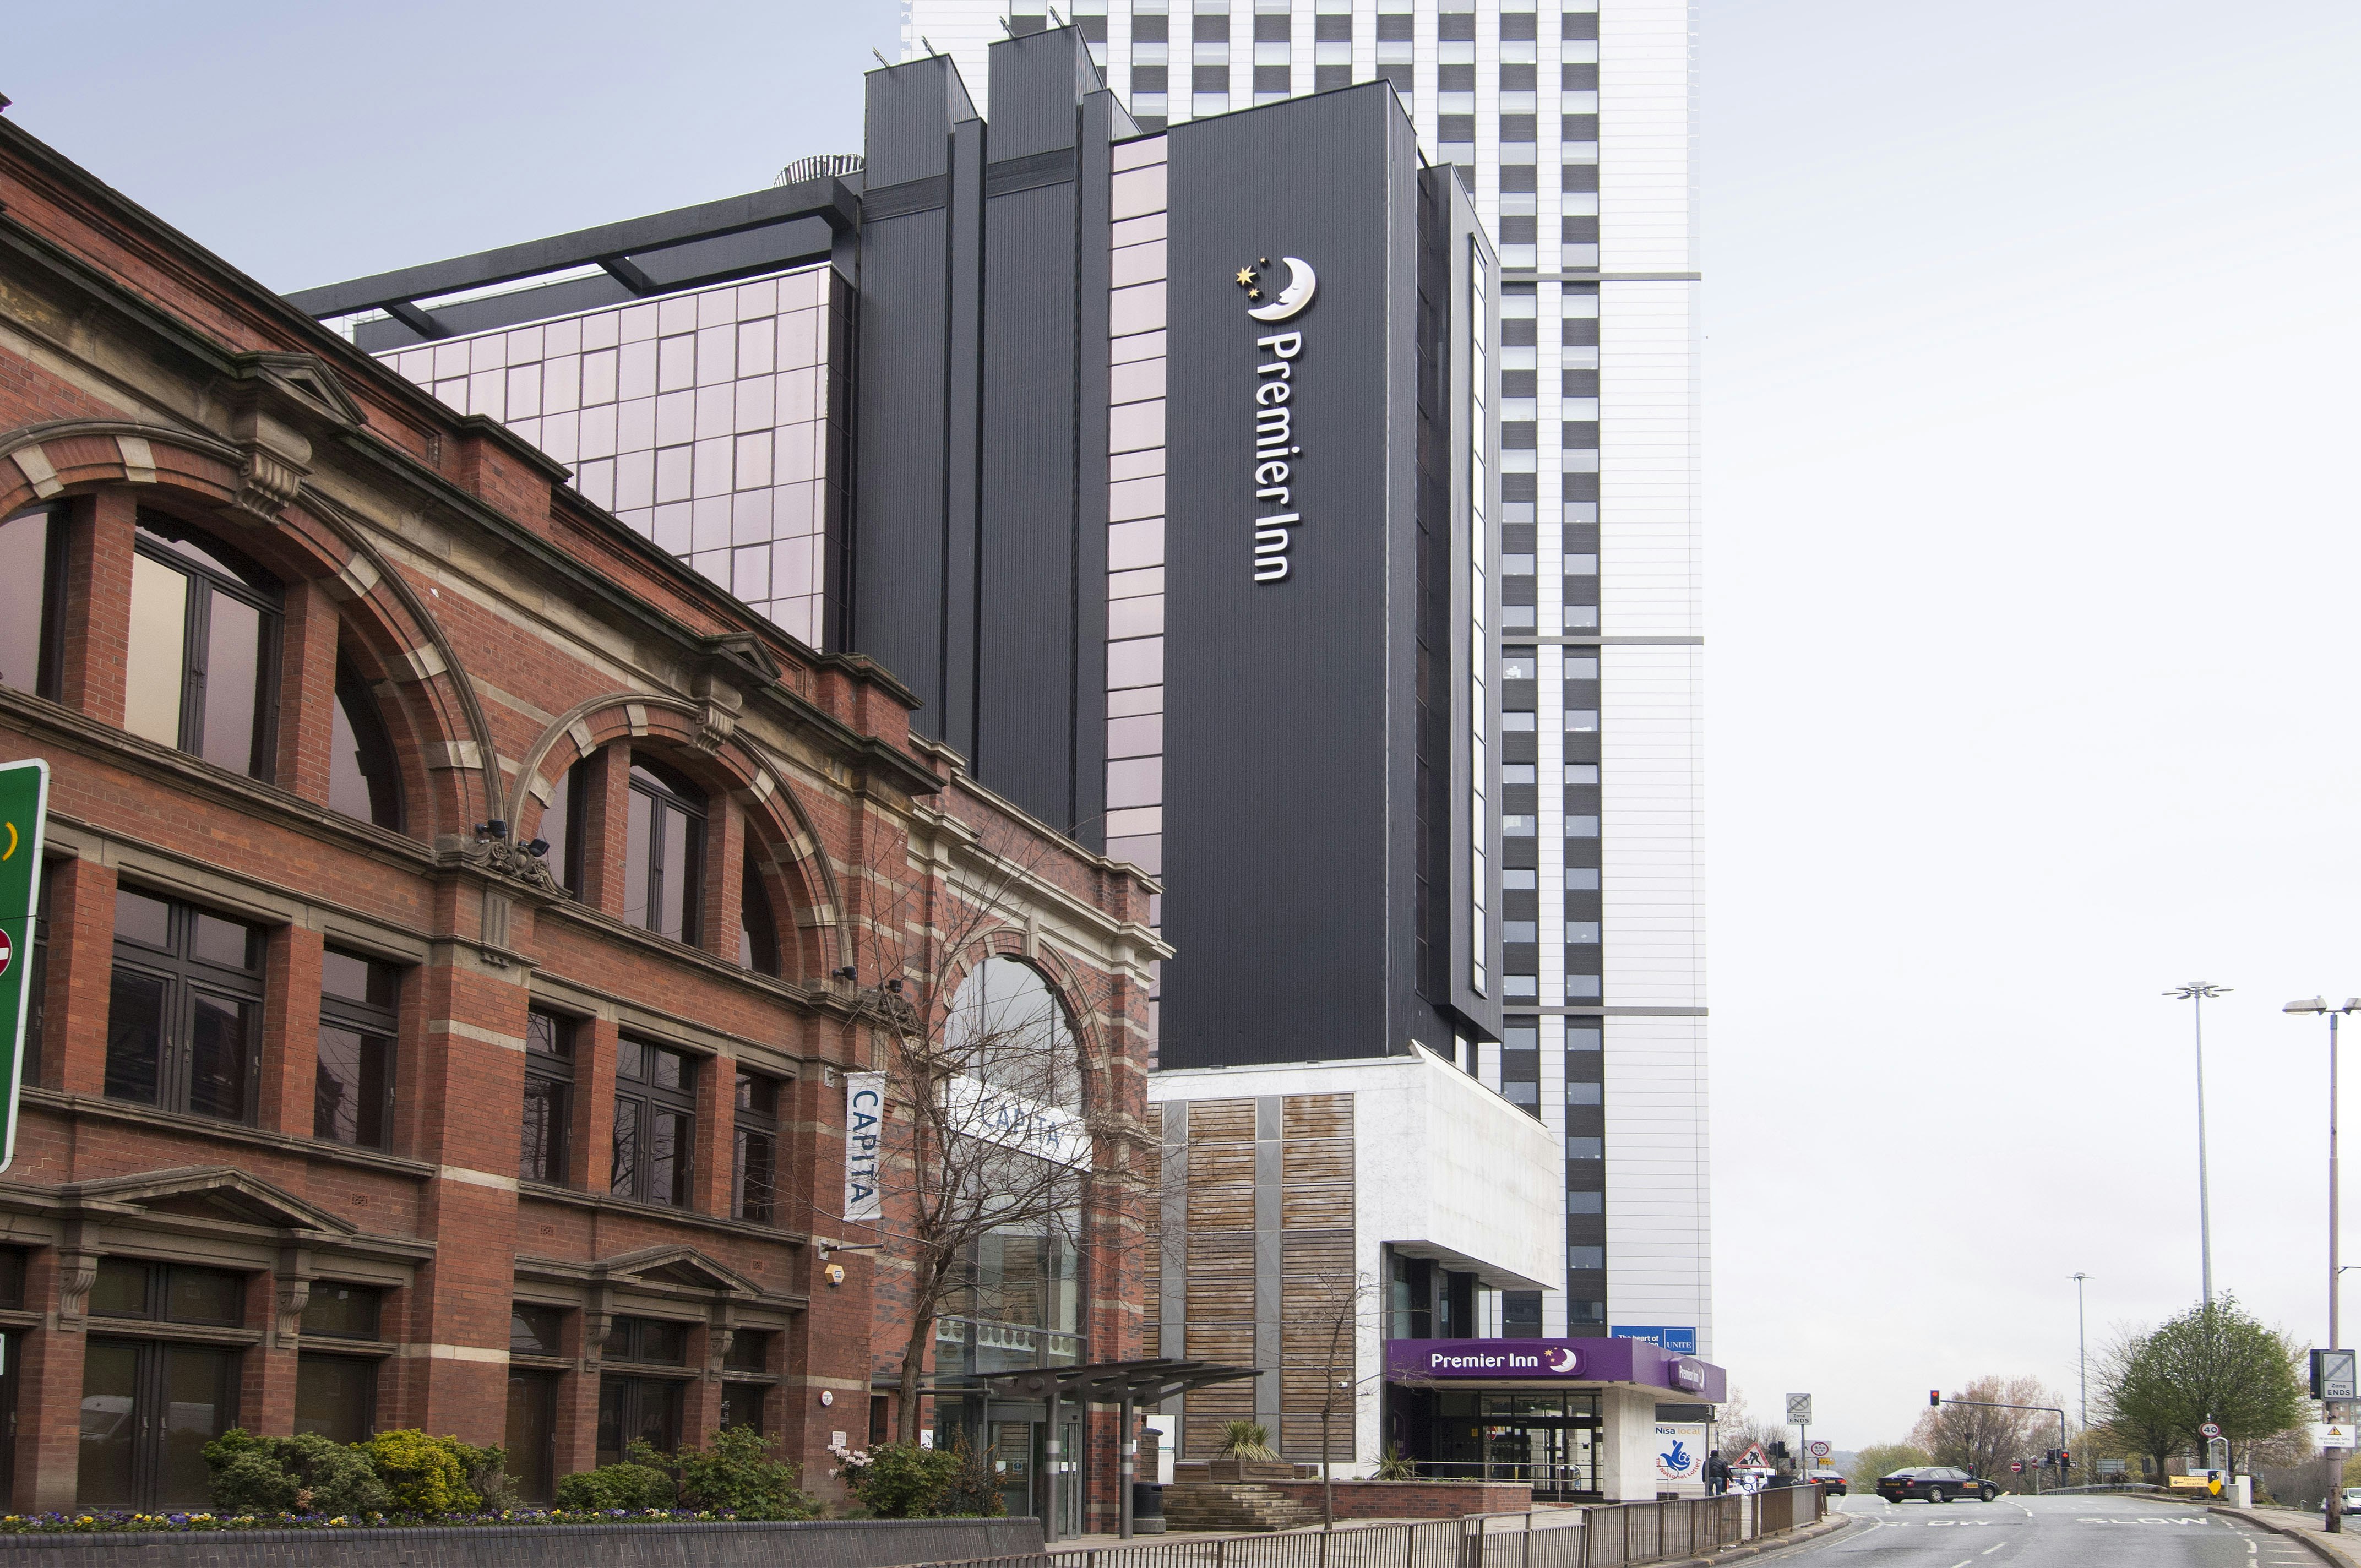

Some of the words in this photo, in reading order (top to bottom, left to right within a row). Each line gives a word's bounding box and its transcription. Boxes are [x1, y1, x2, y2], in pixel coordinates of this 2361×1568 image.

[1255, 331, 1301, 505] Premier
[1254, 513, 1300, 581] Inn
[851, 1090, 878, 1204] CAPITA
[1431, 1353, 1505, 1368] Premier
[1509, 1353, 1538, 1367] Inn
[1659, 1467, 1687, 1479] National
[1687, 1458, 1701, 1477] Lottery
